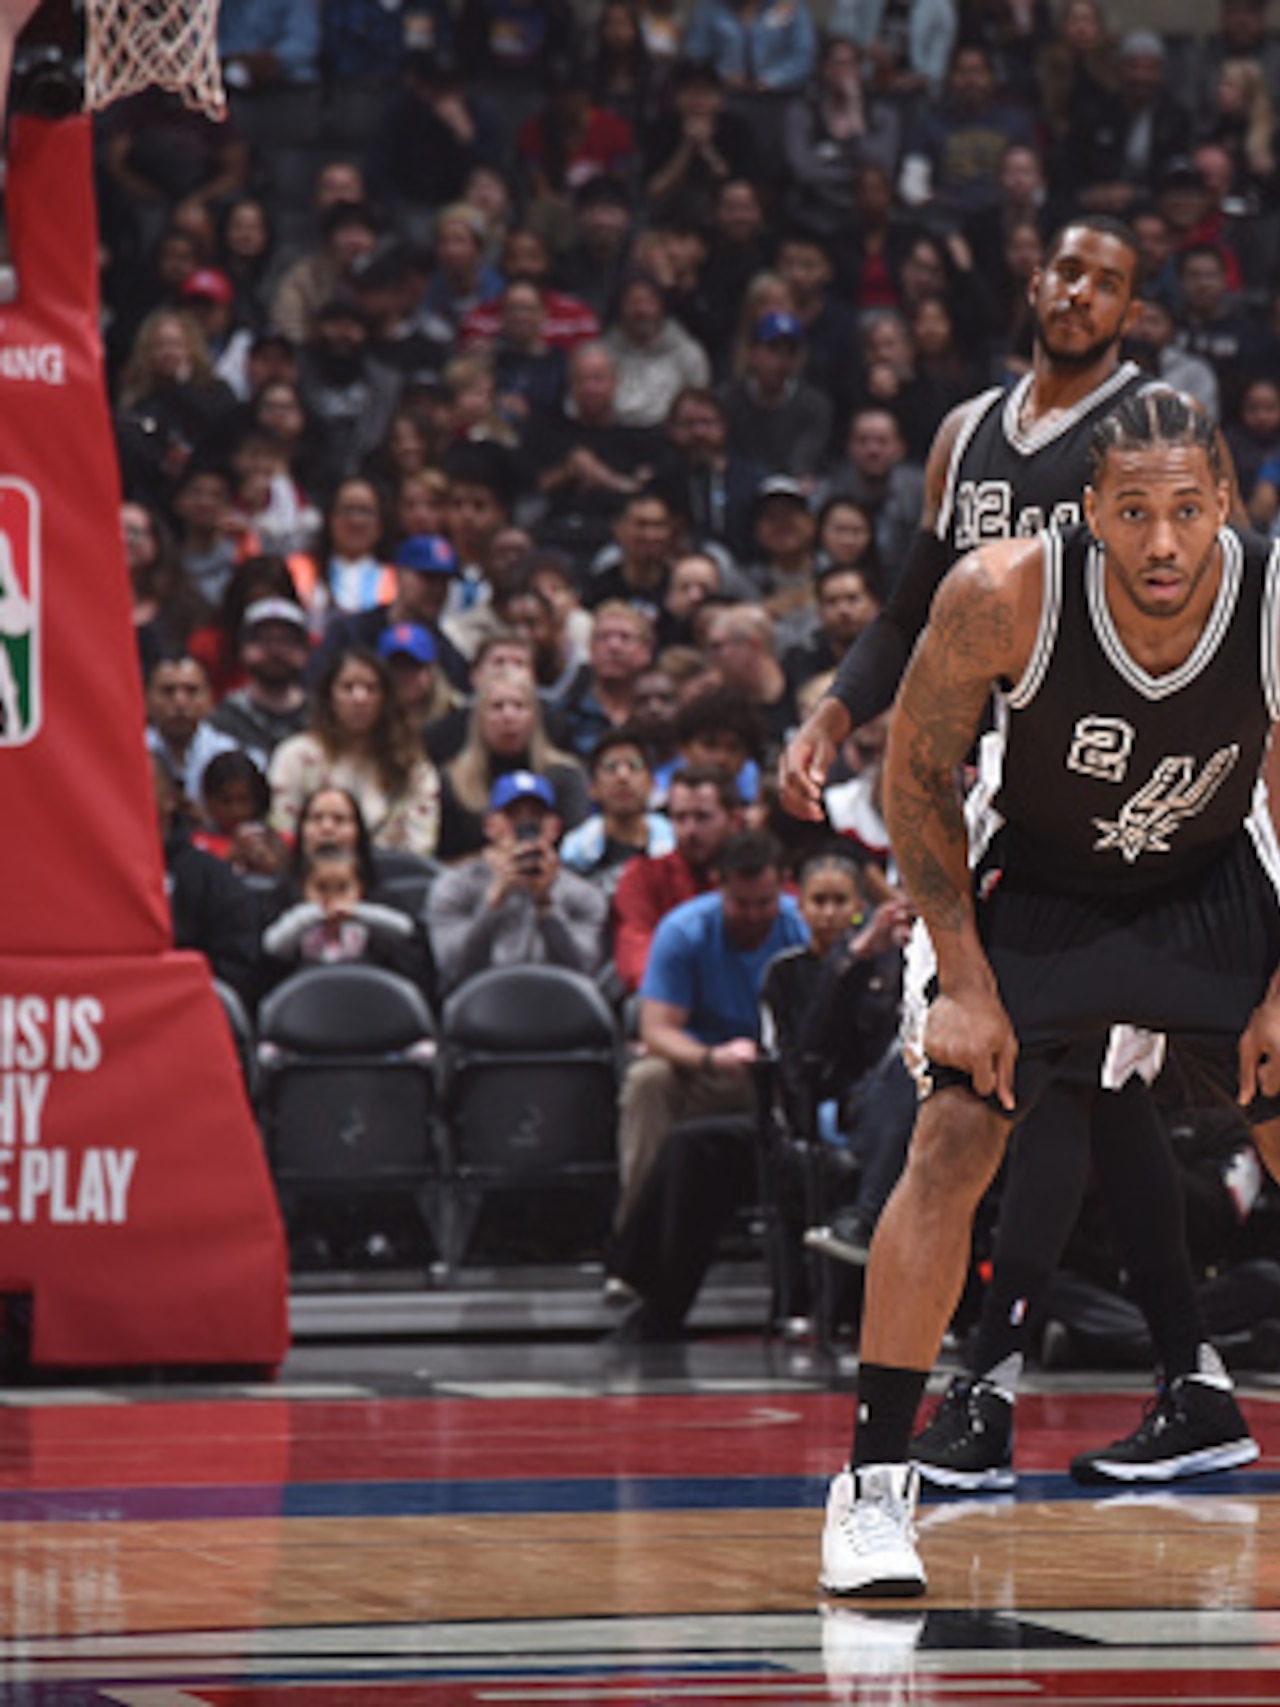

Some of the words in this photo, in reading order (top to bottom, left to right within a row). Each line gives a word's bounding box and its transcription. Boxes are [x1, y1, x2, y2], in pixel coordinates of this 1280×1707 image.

[955, 480, 1012, 549] 12
[1067, 716, 1135, 782] 2
[53, 996, 103, 1071] IS
[19, 1148, 138, 1224] PLAY
